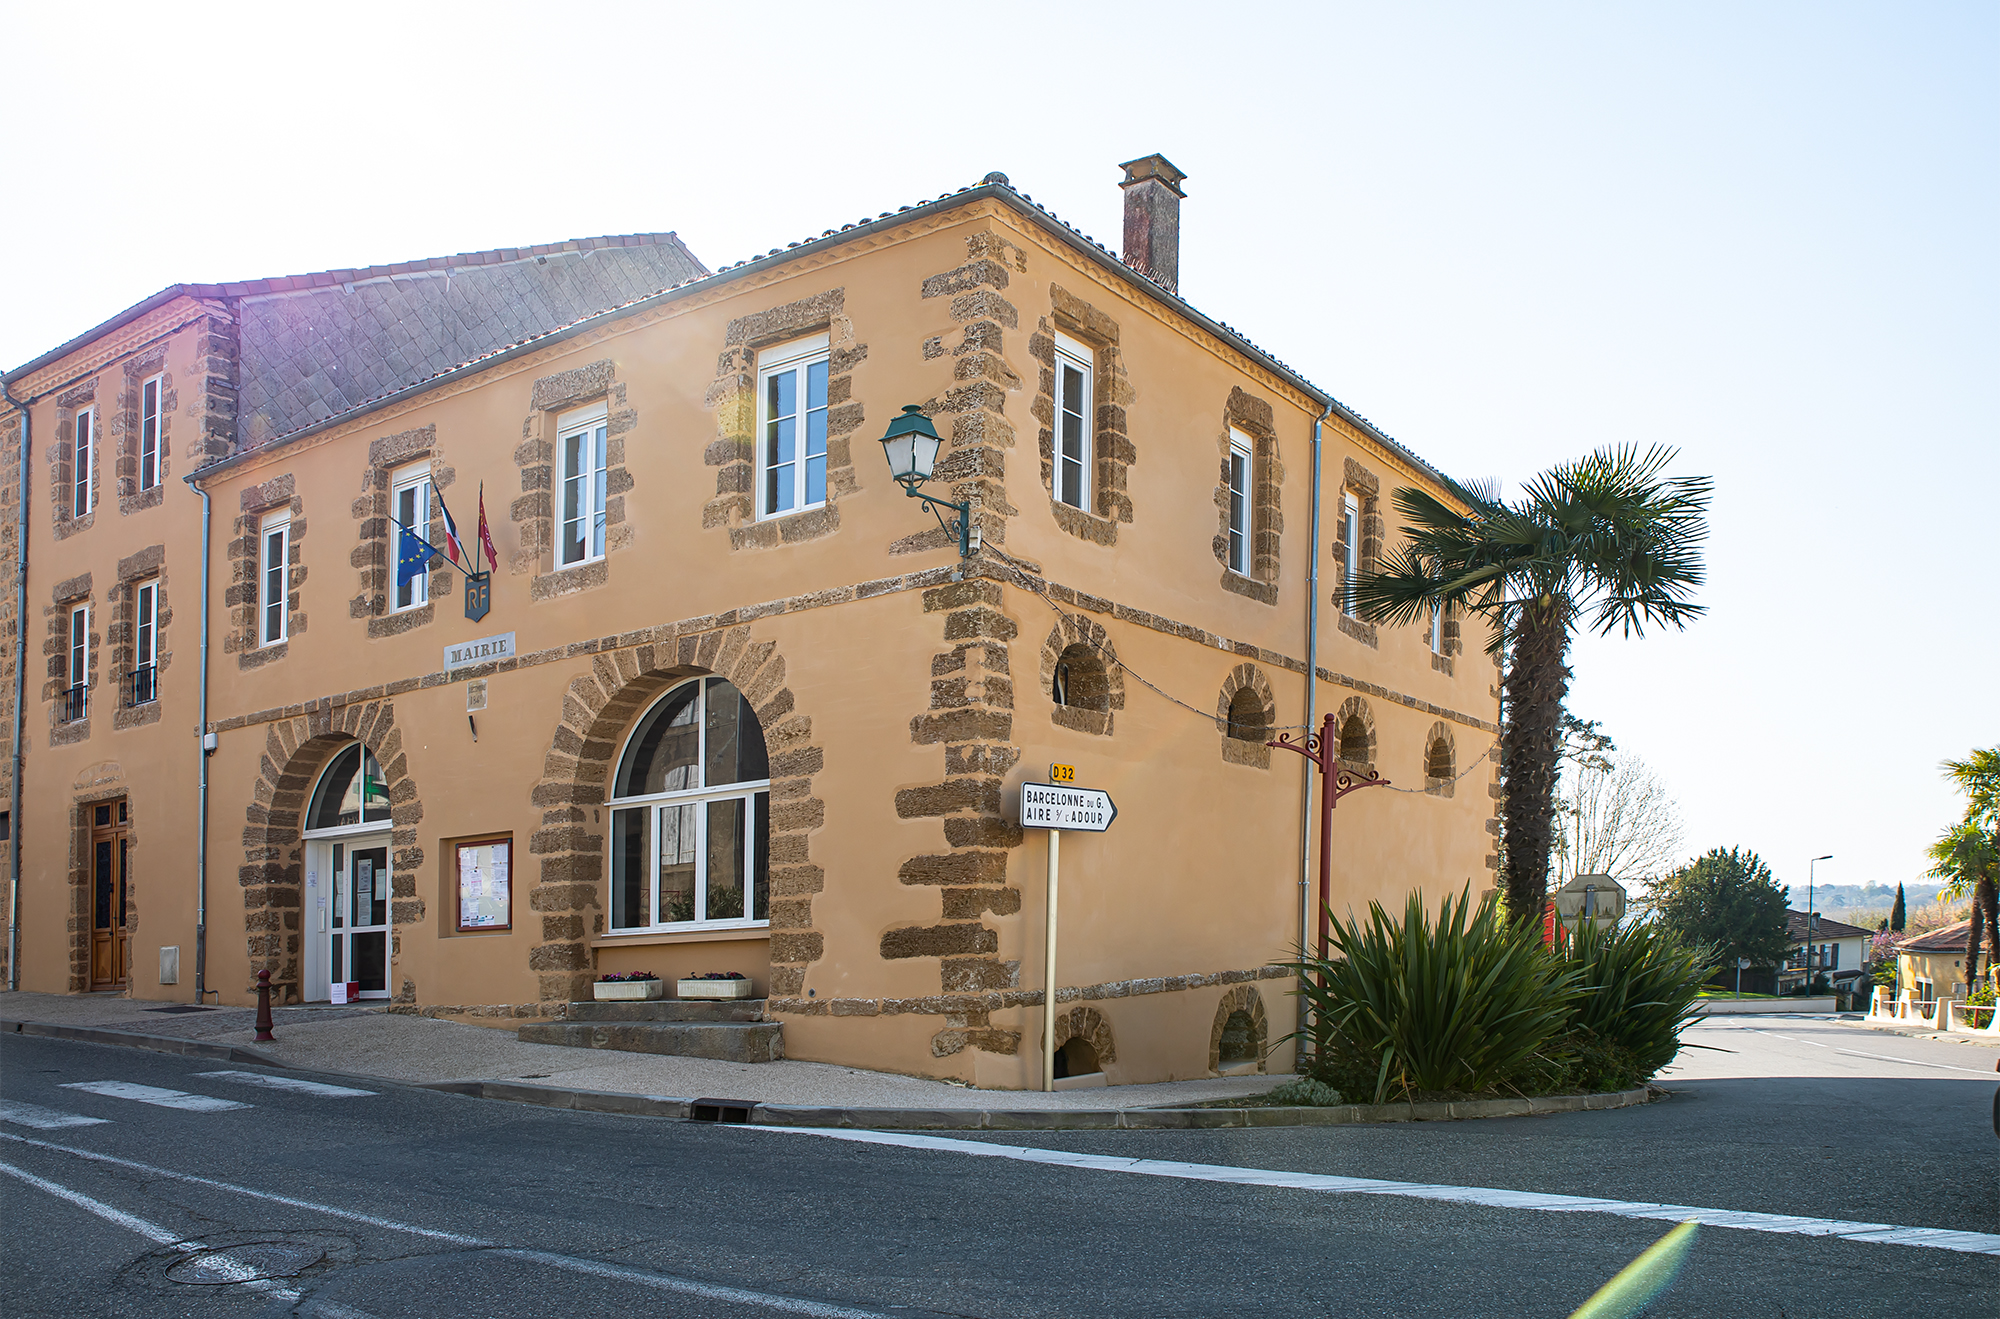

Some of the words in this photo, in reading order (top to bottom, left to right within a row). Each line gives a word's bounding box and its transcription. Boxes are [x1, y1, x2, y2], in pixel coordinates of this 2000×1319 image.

[467, 585, 487, 611] RF
[451, 640, 507, 663] MAIRIE
[1053, 766, 1059, 778] D
[1062, 767, 1073, 780] 32
[1026, 791, 1084, 808] BARCELONNE
[1096, 797, 1104, 809] G.
[1026, 807, 1051, 821] AIRE
